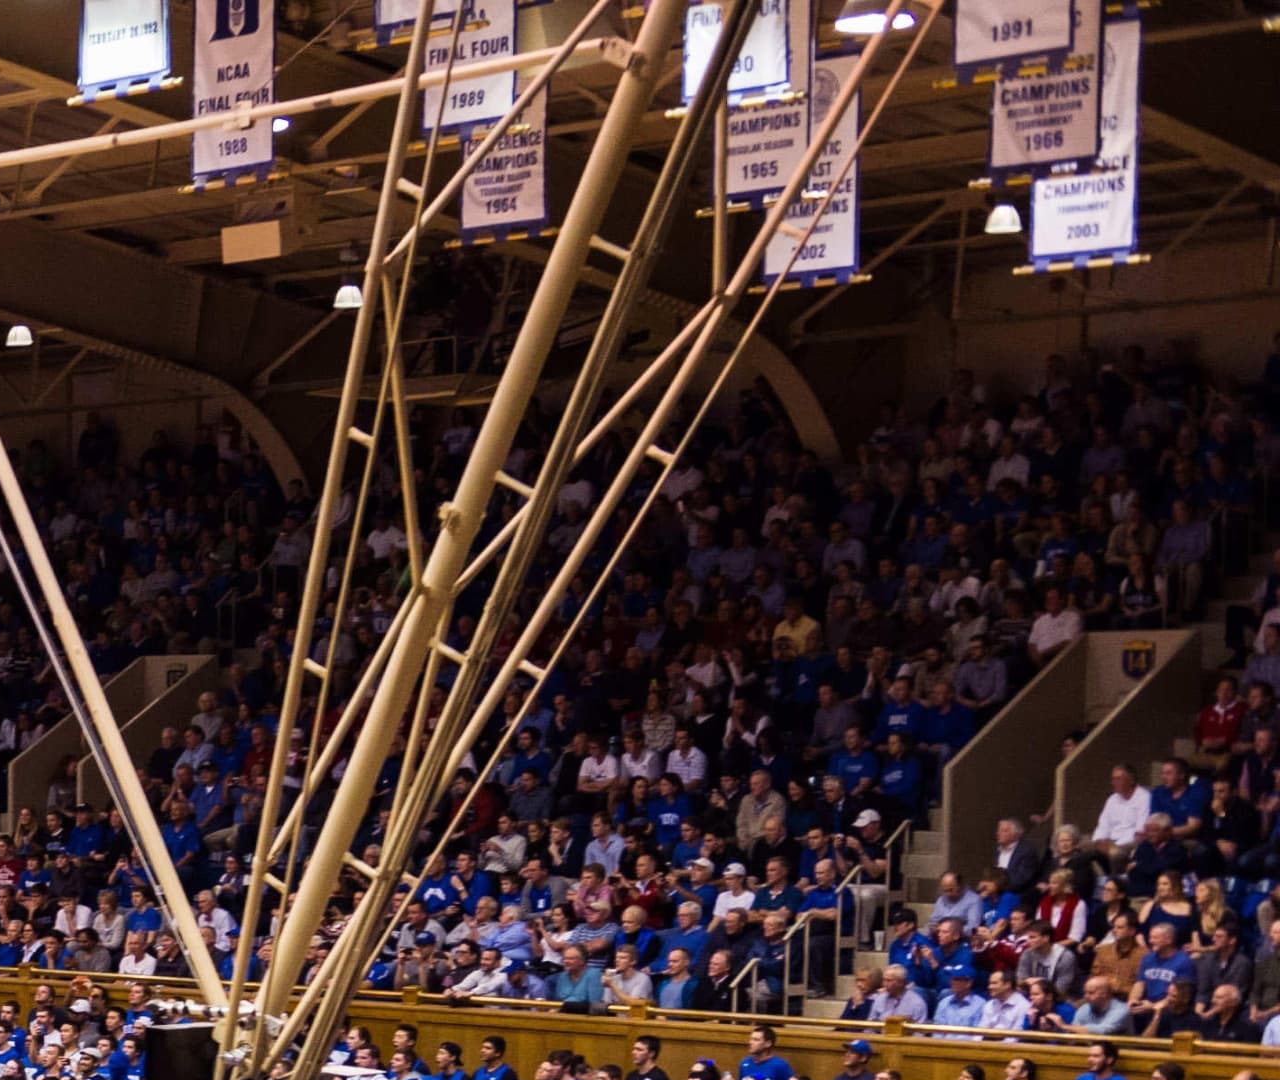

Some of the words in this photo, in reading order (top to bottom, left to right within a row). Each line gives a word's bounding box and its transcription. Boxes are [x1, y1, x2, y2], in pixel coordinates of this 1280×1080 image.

[991, 19, 1033, 43] 1991
[471, 36, 509, 58] FOUR
[217, 63, 250, 82] NCAA
[451, 90, 485, 109] 1989
[1001, 78, 1090, 106] CHAMPIONS
[199, 95, 233, 115] FINAL
[218, 138, 247, 157] 1988
[1025, 131, 1064, 151] 1966
[742, 161, 778, 179] 1965
[1043, 176, 1126, 200] CHAMPIONS
[486, 197, 517, 214] 1964
[1067, 223, 1099, 240] 2003
